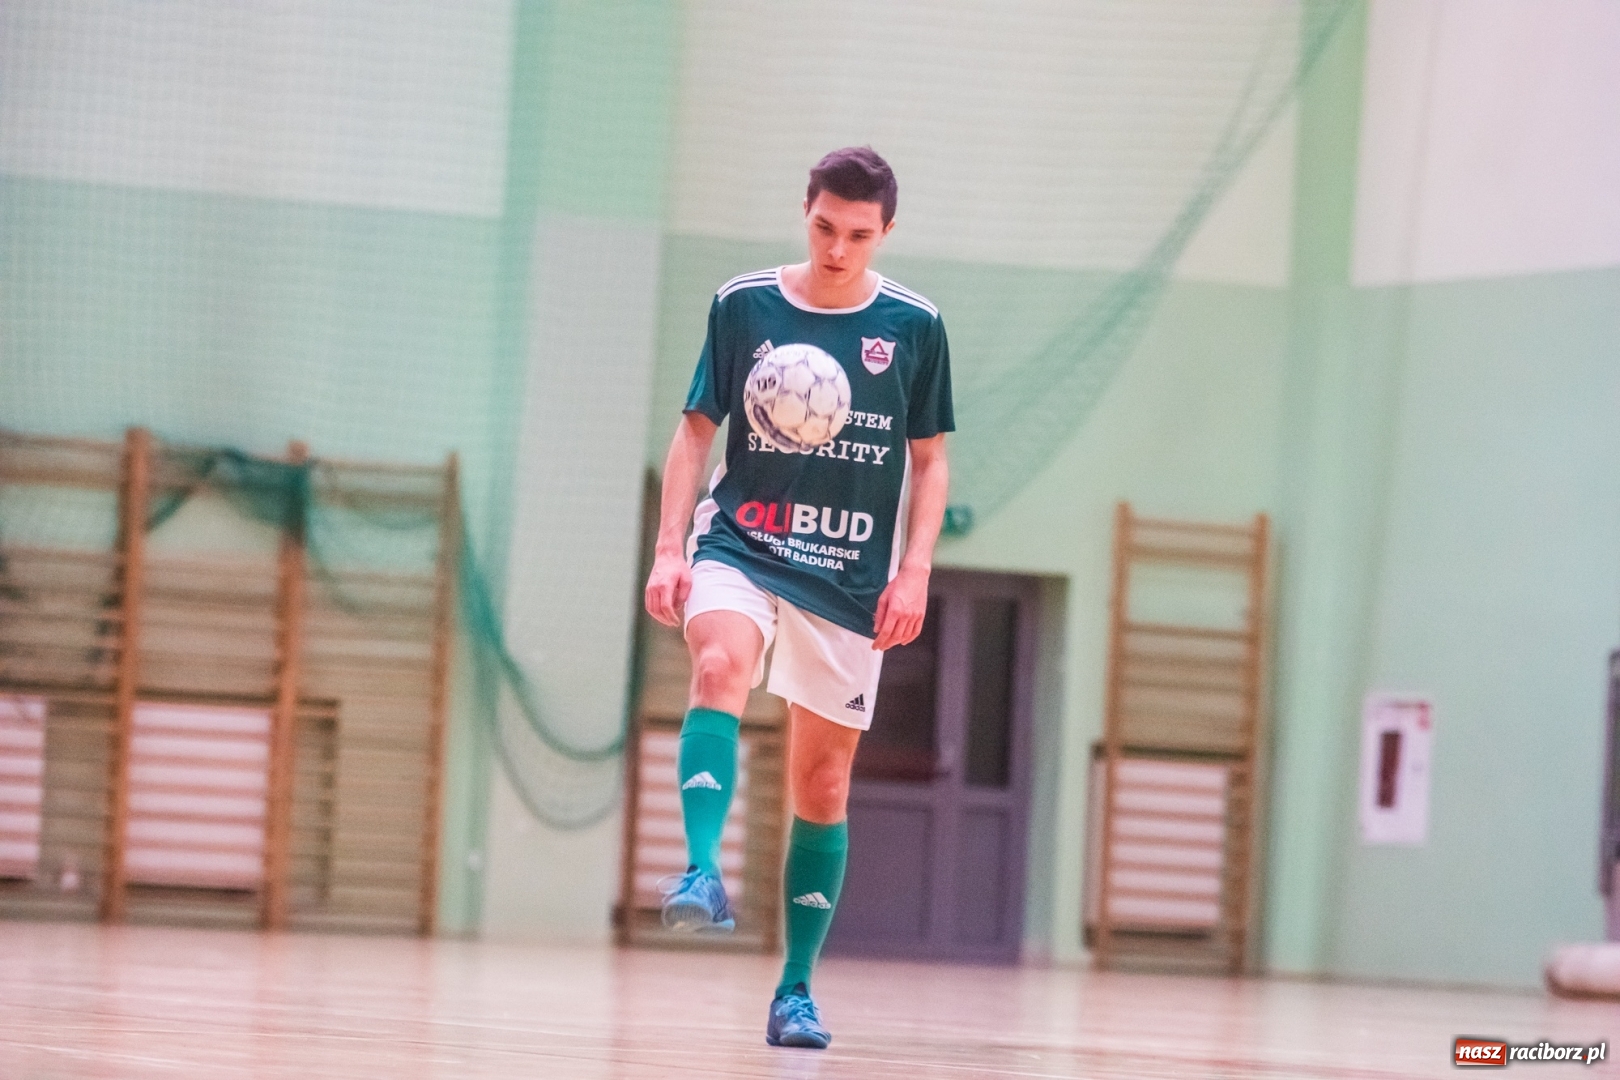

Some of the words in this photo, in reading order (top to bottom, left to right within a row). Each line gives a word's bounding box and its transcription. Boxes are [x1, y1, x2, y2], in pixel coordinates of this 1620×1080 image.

[748, 432, 890, 465] SERITY
[735, 501, 874, 542] OLIBUD
[787, 537, 860, 560] BRUKARSKIE
[793, 551, 844, 571] BADURA
